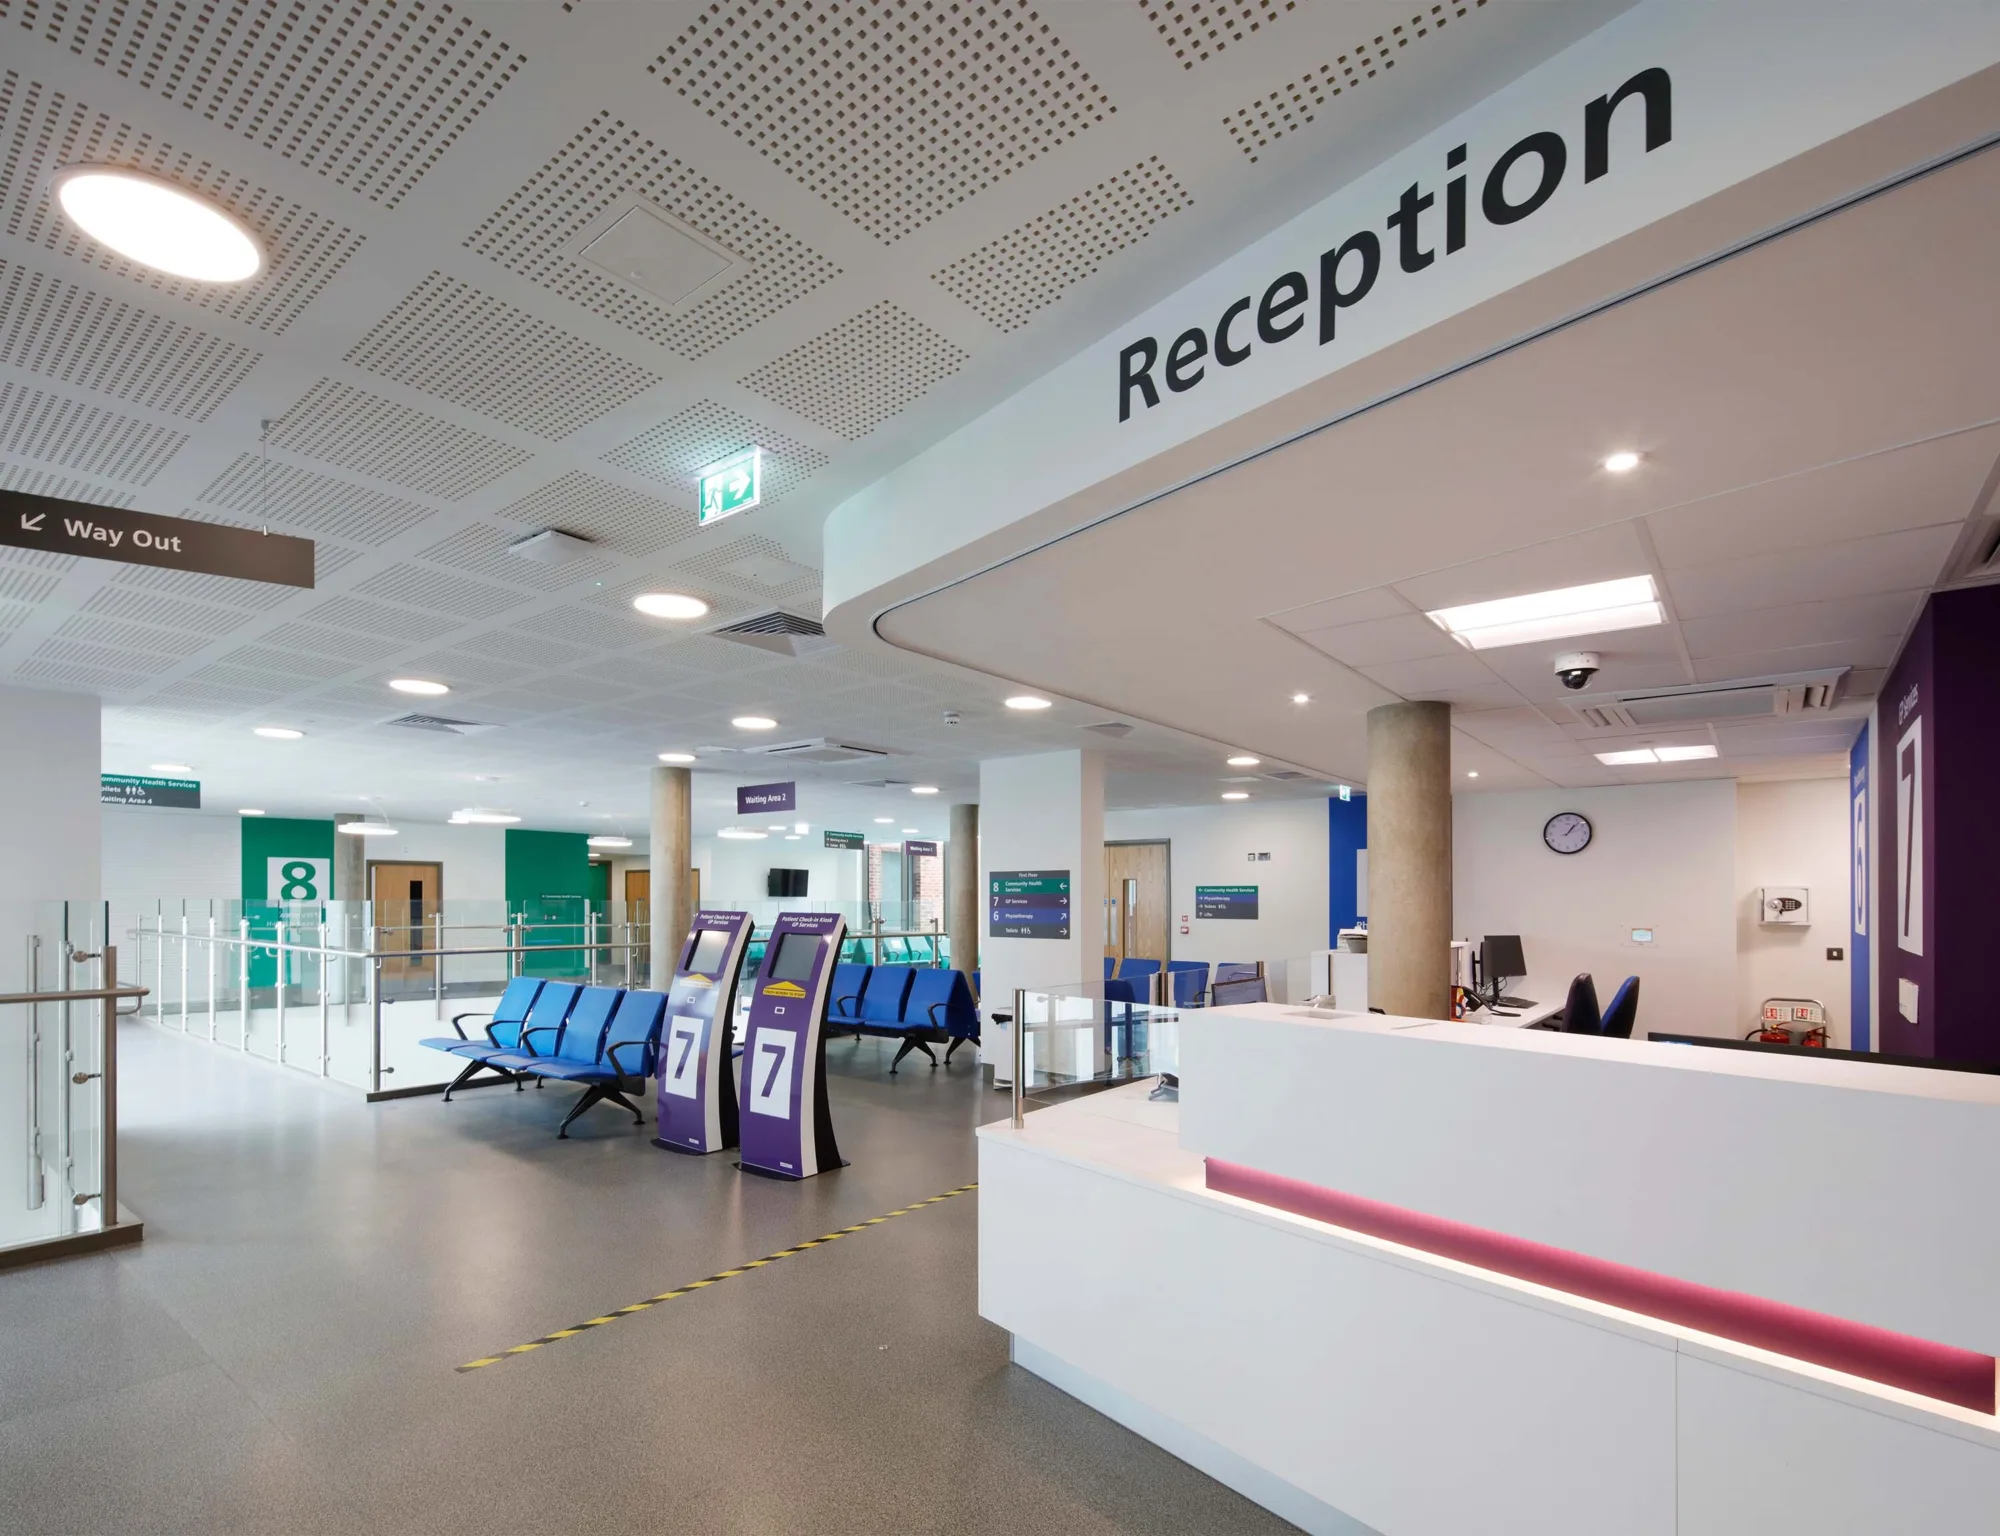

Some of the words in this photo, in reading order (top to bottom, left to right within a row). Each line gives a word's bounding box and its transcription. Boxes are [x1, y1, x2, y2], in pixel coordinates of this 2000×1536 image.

[1119, 67, 1672, 423] Reception
[64, 518, 124, 547] Way
[132, 529, 182, 553] Out
[101, 776, 141, 786] ommunity
[142, 778, 166, 787] Health
[168, 780, 197, 789] Services
[101, 785, 121, 793] oilets
[128, 797, 146, 805] Area
[745, 795, 767, 805] Waiting
[768, 794, 781, 803] Area
[782, 793, 787, 801] 2
[1901, 738, 1915, 938] 7
[281, 861, 317, 902] 8
[993, 882, 999, 892] 8
[993, 896, 999, 907] 7
[993, 911, 999, 921] 6
[674, 1030, 695, 1079] 7
[760, 1043, 786, 1098] 7
